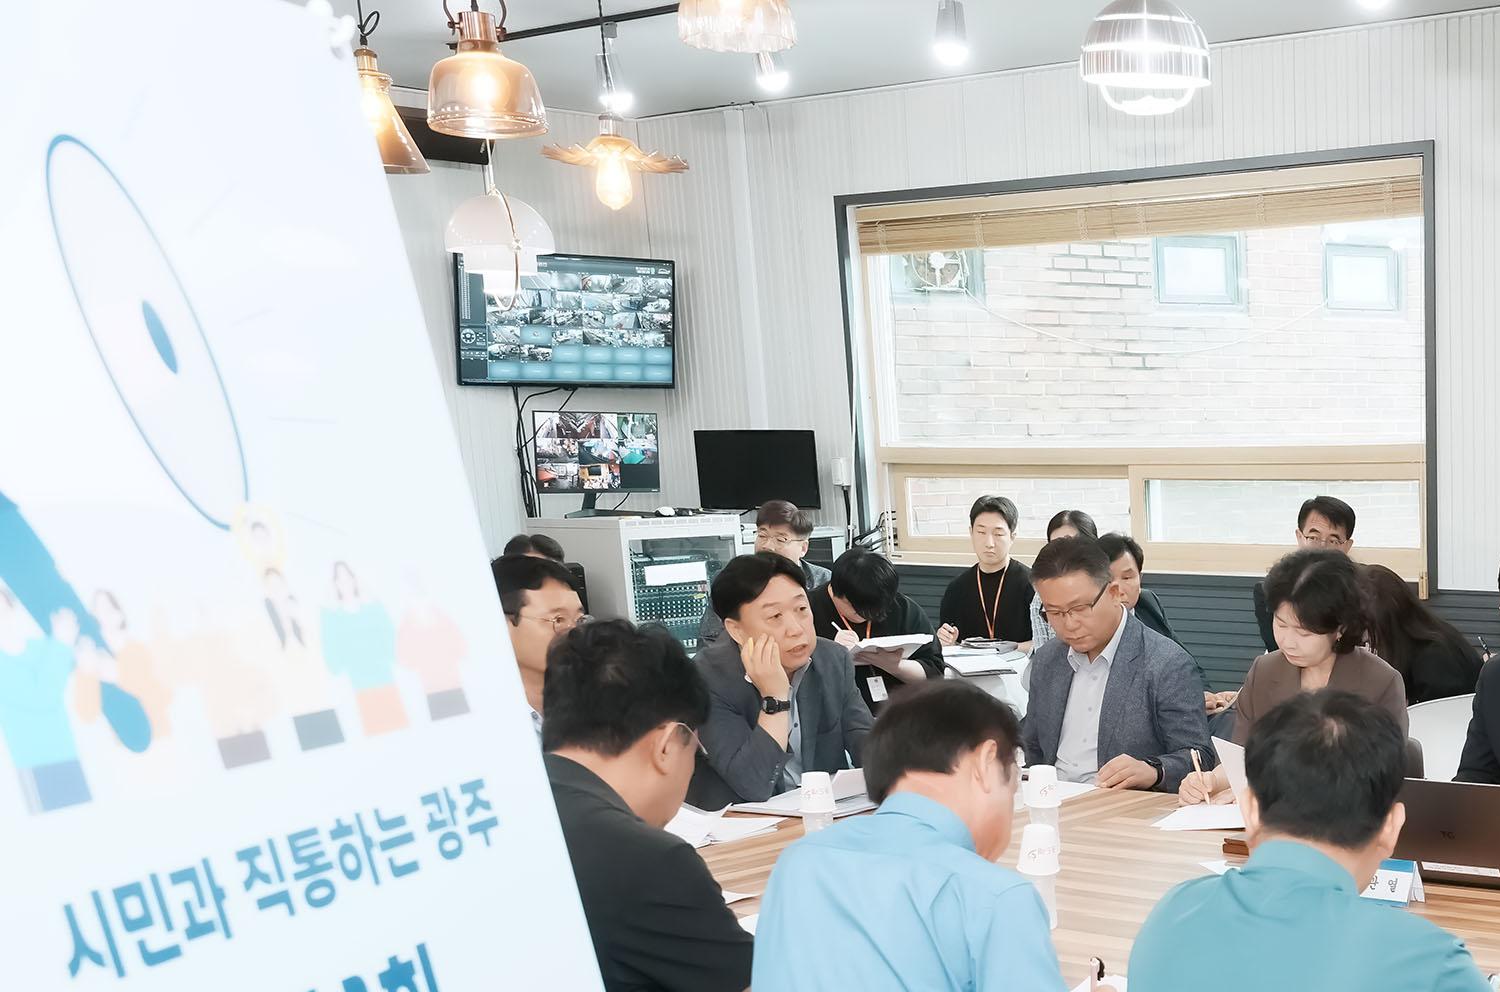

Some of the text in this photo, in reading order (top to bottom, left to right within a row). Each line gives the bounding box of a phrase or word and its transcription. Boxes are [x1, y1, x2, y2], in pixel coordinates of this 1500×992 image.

[62, 778, 501, 979] 시민과 직통하는 광주
